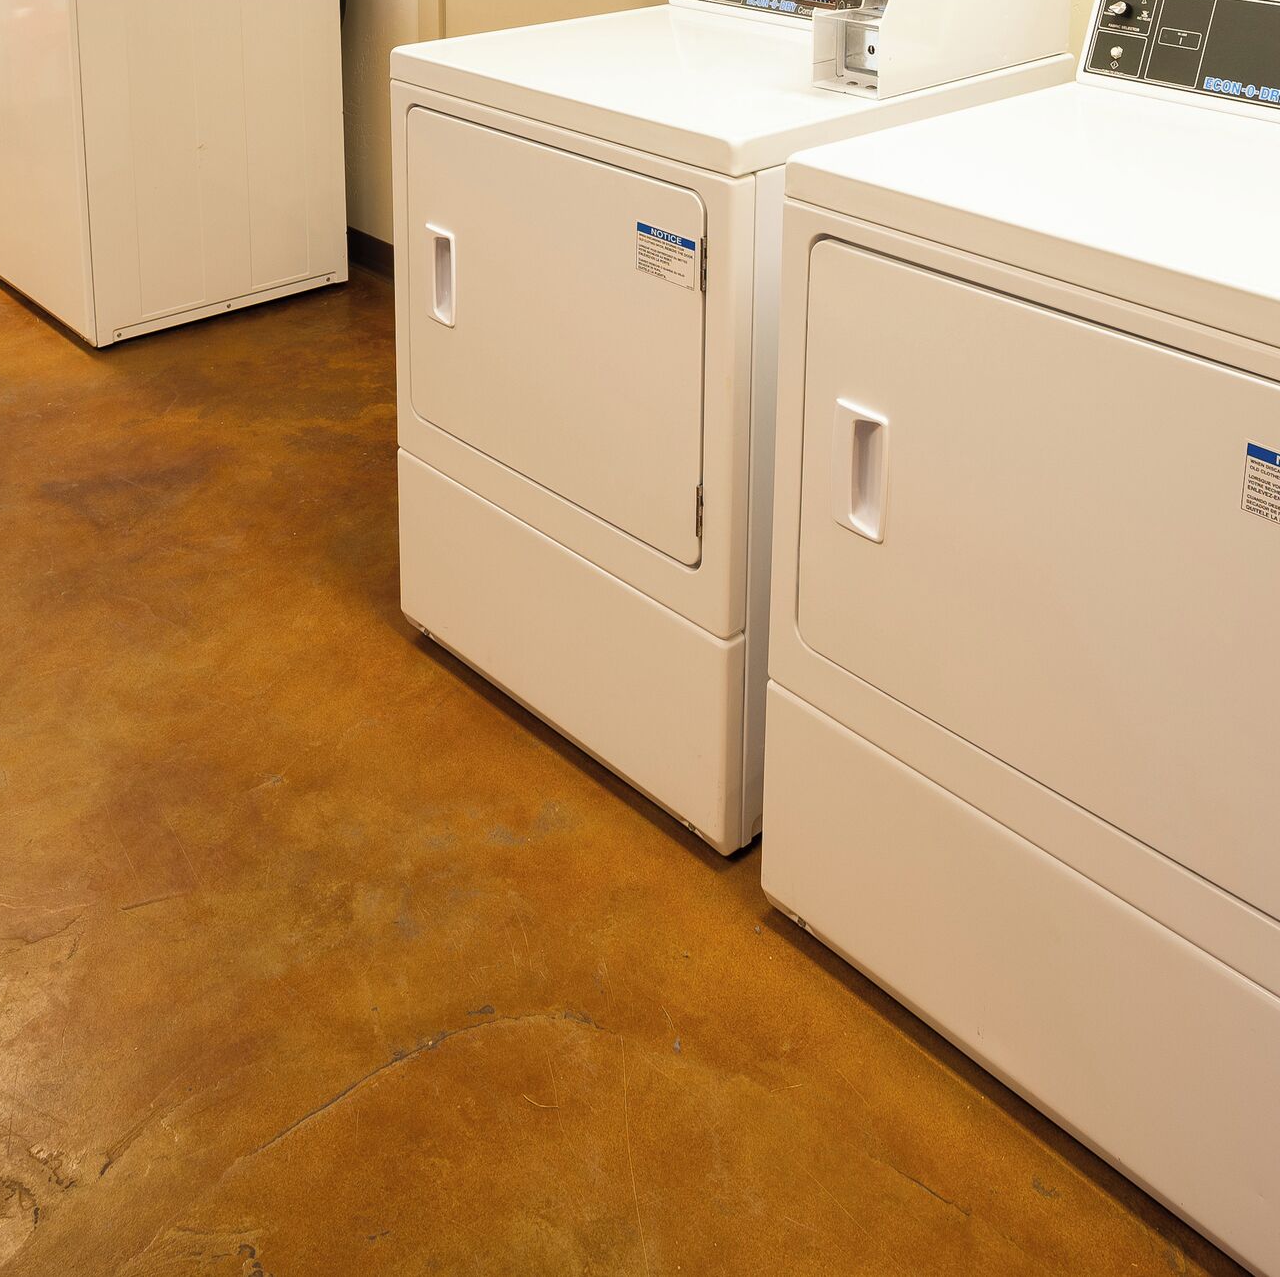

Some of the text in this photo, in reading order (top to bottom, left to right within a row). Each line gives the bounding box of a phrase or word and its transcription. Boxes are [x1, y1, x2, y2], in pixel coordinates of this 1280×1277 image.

[651, 228, 682, 245] NOTICE
[1250, 459, 1265, 469] WHEN
[1248, 480, 1264, 489] VOTRE
[1249, 474, 1271, 486] LORSQUE
[1246, 499, 1270, 513] SECADOR
[1247, 494, 1267, 506] CUANDO
[1246, 505, 1269, 517] QUITELE
[1271, 514, 1278, 522] LA
